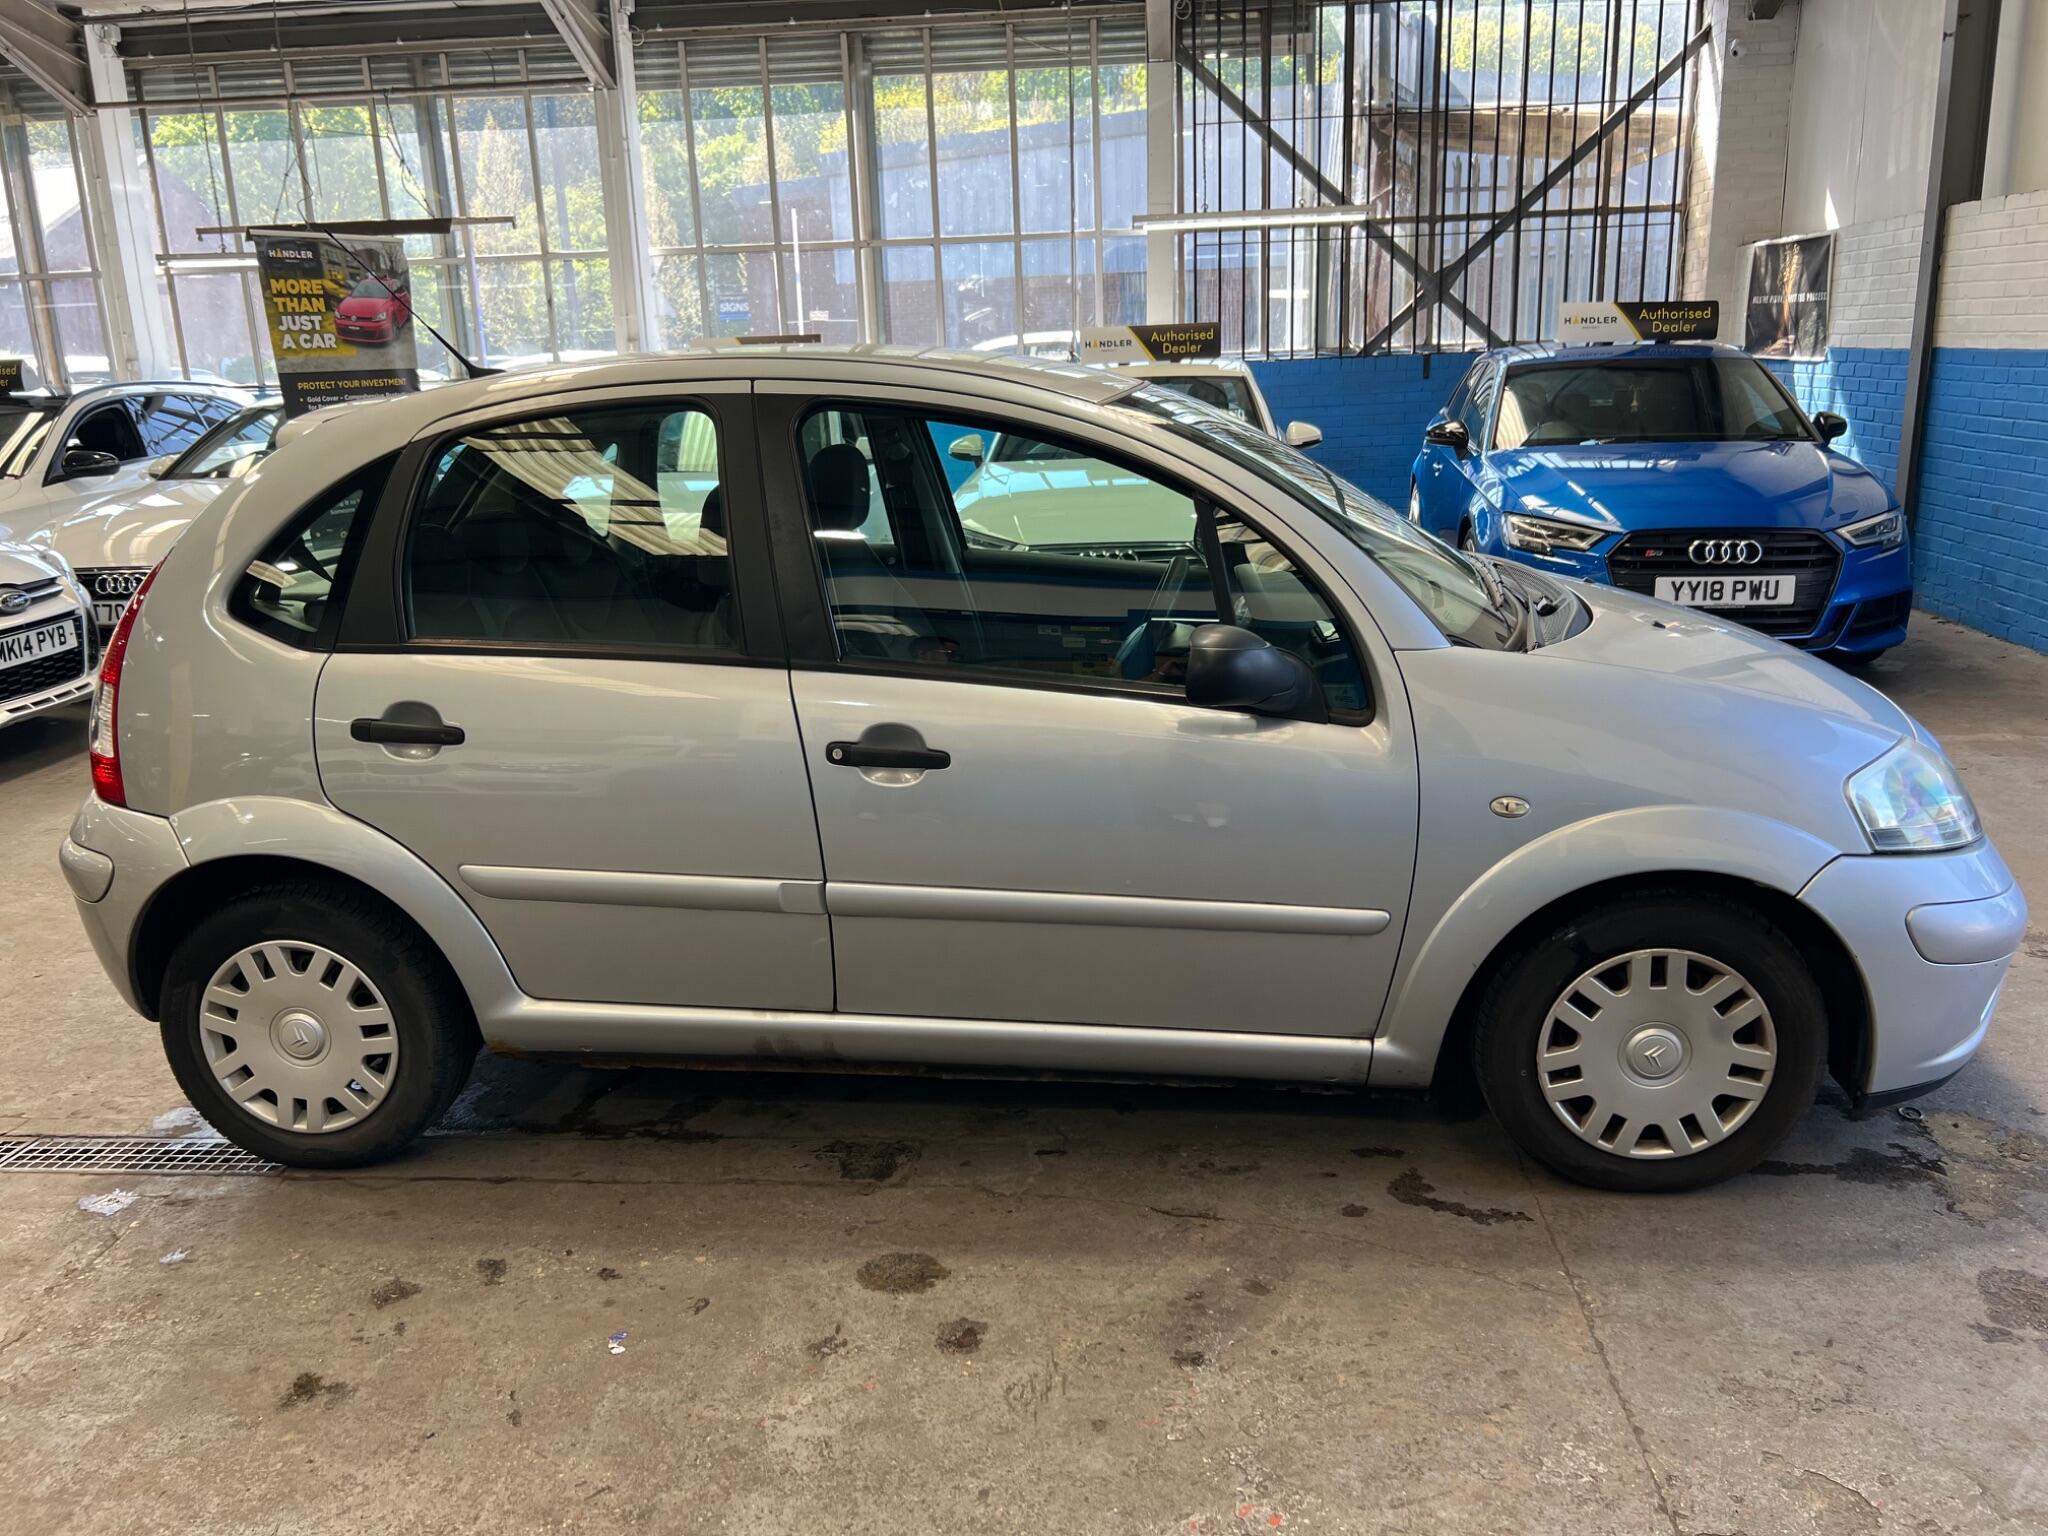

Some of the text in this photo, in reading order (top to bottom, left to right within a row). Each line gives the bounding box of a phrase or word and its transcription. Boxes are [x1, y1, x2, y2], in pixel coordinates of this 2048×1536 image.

[270, 279, 324, 295] MORE
[272, 297, 326, 312] THAN
[1639, 307, 1711, 320] Authorised
[278, 315, 323, 331] JUST
[1652, 321, 1697, 333] Dealer
[282, 333, 337, 349] A CAR
[1150, 328, 1214, 342] Authorised
[1162, 342, 1202, 354] Dealer
[297, 378, 407, 391] PROTECT YOUR INVESTMENT
[1671, 579, 1780, 601] YY18 PWU
[36, 625, 67, 652] PYB
